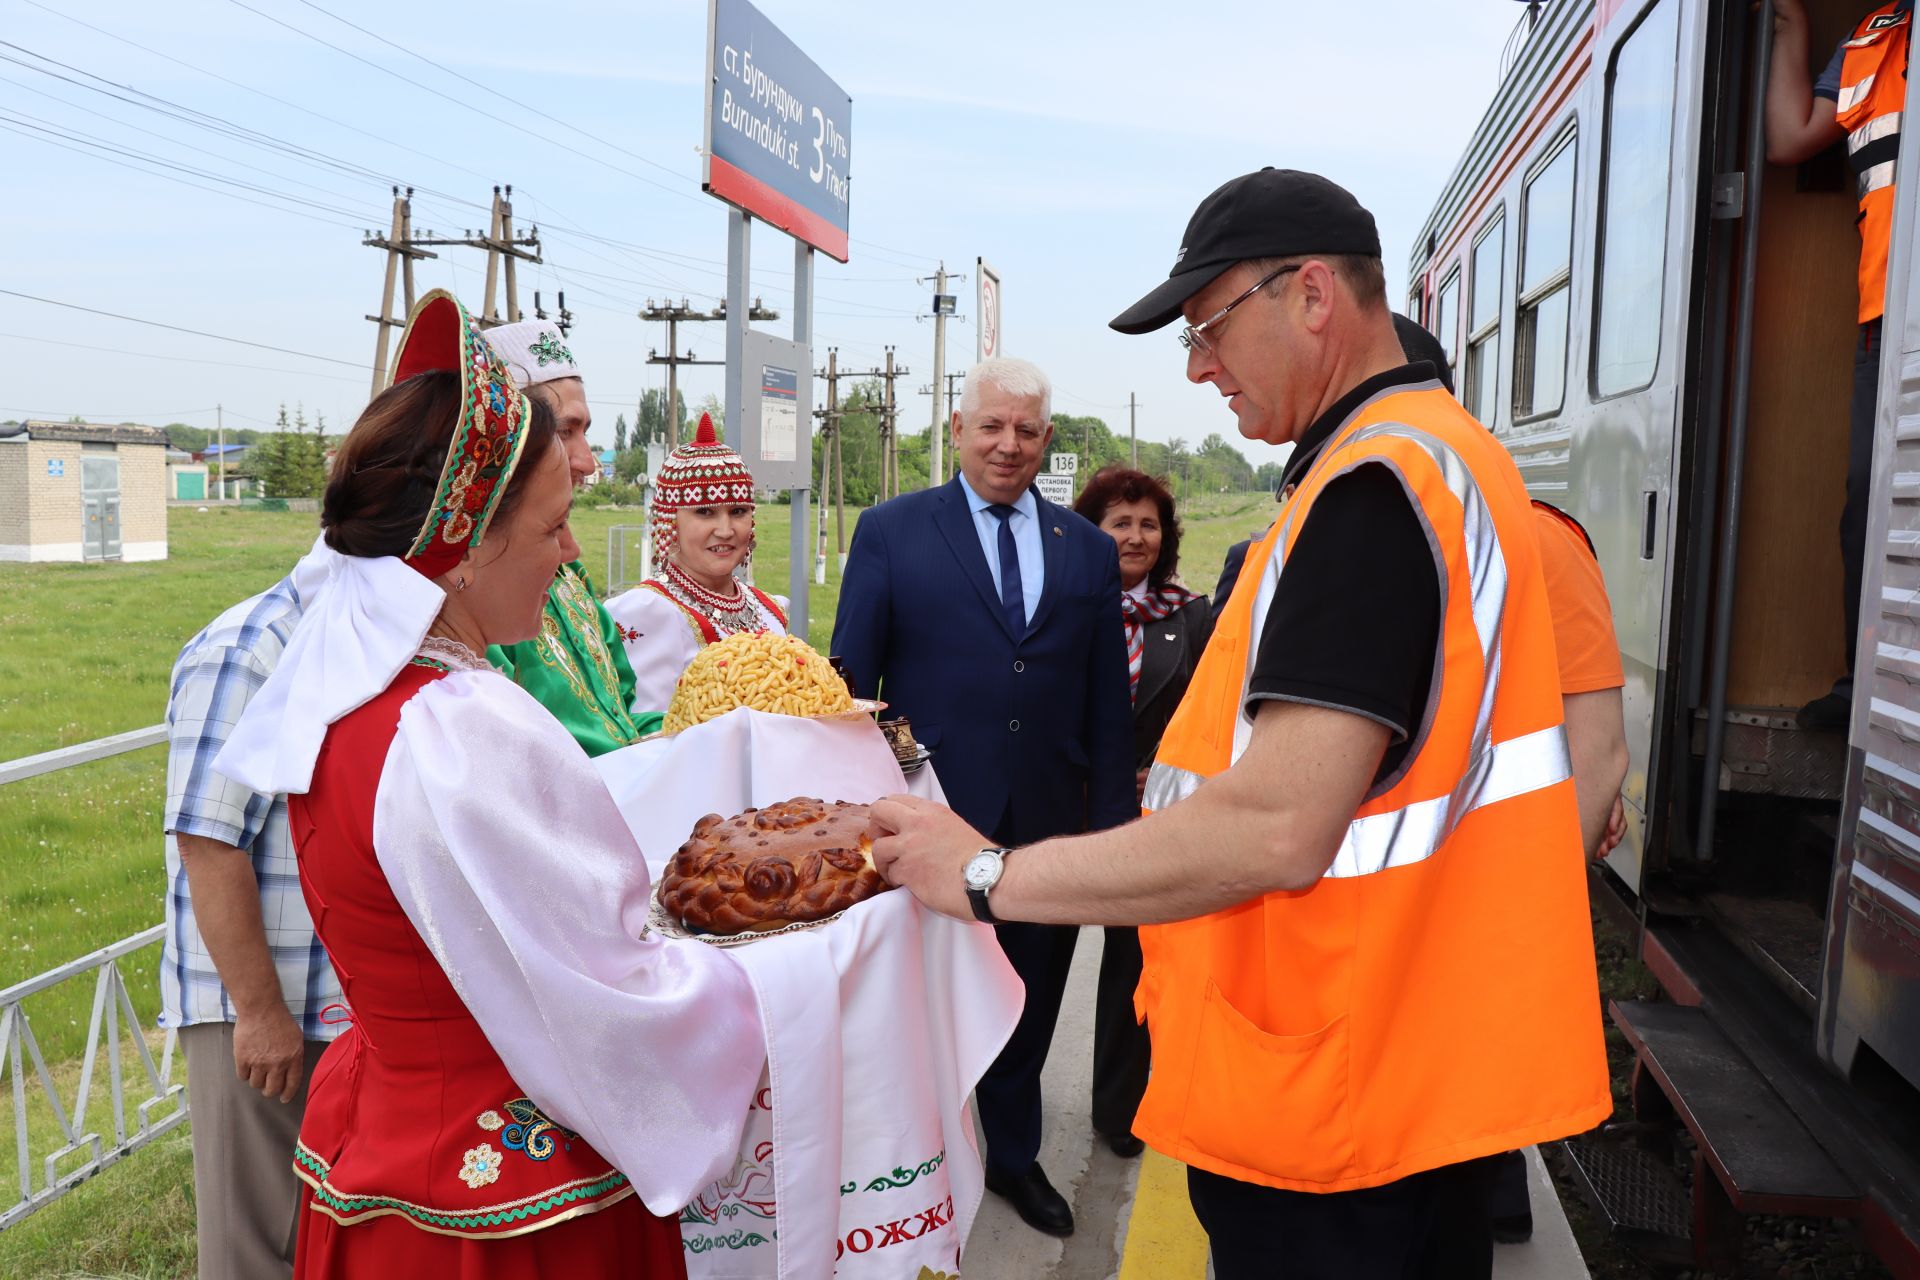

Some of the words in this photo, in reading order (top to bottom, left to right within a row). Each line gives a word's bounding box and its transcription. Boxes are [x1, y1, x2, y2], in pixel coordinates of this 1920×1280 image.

[723, 44, 740, 78] ст.
[743, 50, 803, 125] Бурундуки
[722, 88, 786, 160] Burunduki
[787, 140, 800, 170] st.
[809, 106, 825, 184] 3
[826, 118, 847, 159] Путь
[825, 163, 848, 205] Track
[1055, 456, 1074, 471] 136
